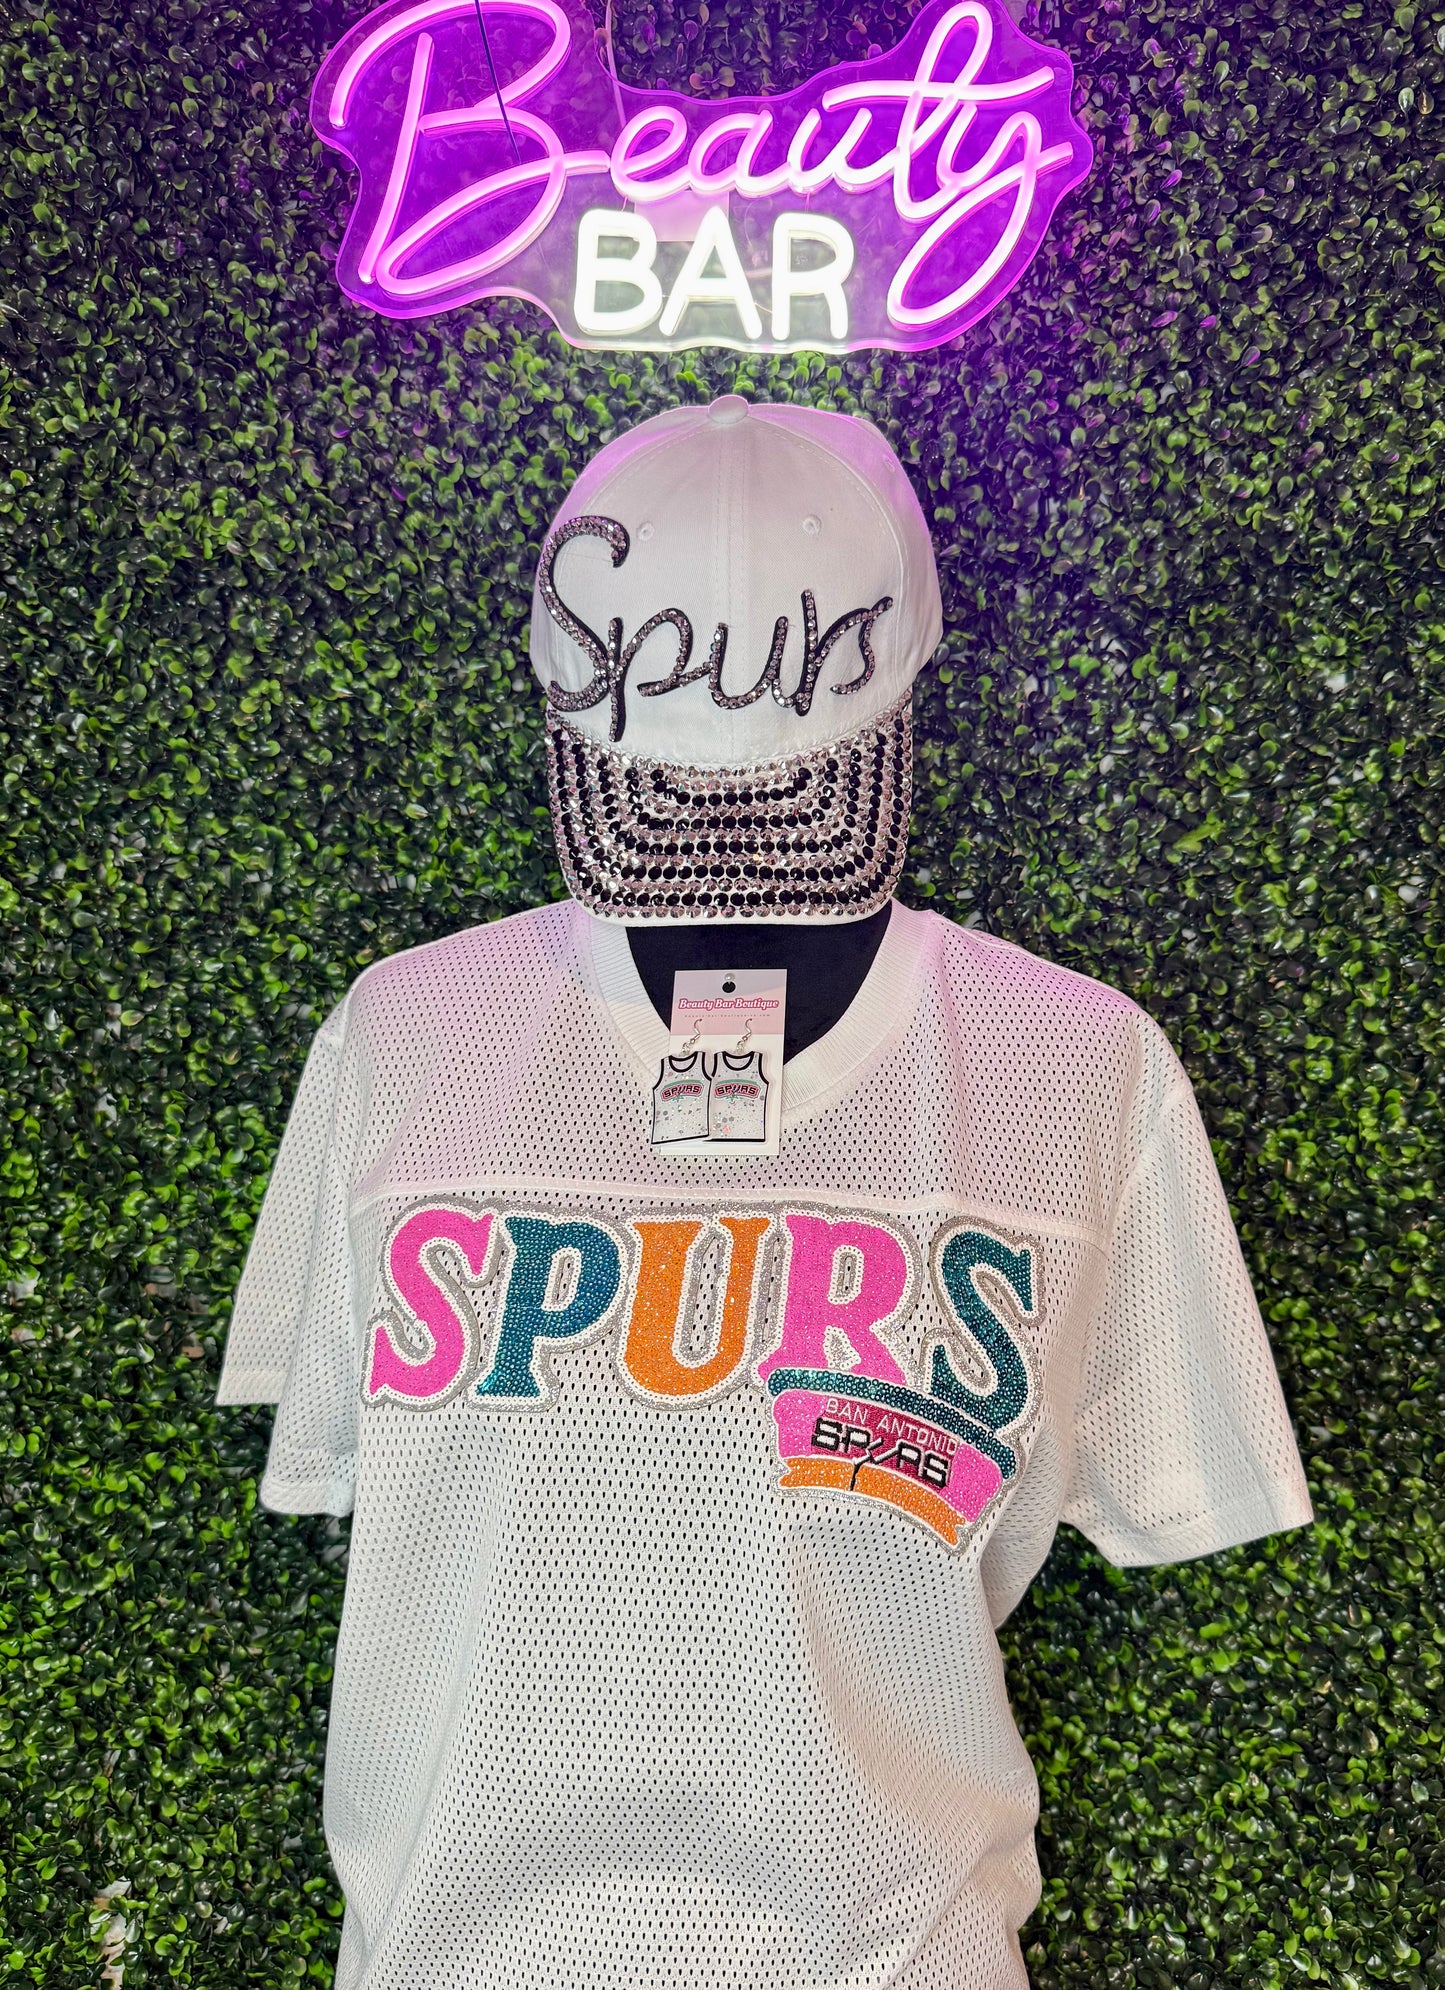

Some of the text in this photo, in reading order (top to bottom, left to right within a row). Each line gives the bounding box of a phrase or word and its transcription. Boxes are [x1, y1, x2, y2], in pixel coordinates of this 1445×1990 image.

[330, 0, 1073, 328] Beauty
[573, 207, 856, 341] BAR
[539, 515, 893, 742] Spurs
[678, 998, 780, 1011] Beauty Bar Boutique
[365, 1205, 1038, 1435] SPURS
[876, 1414, 959, 1456] ANTONIO
